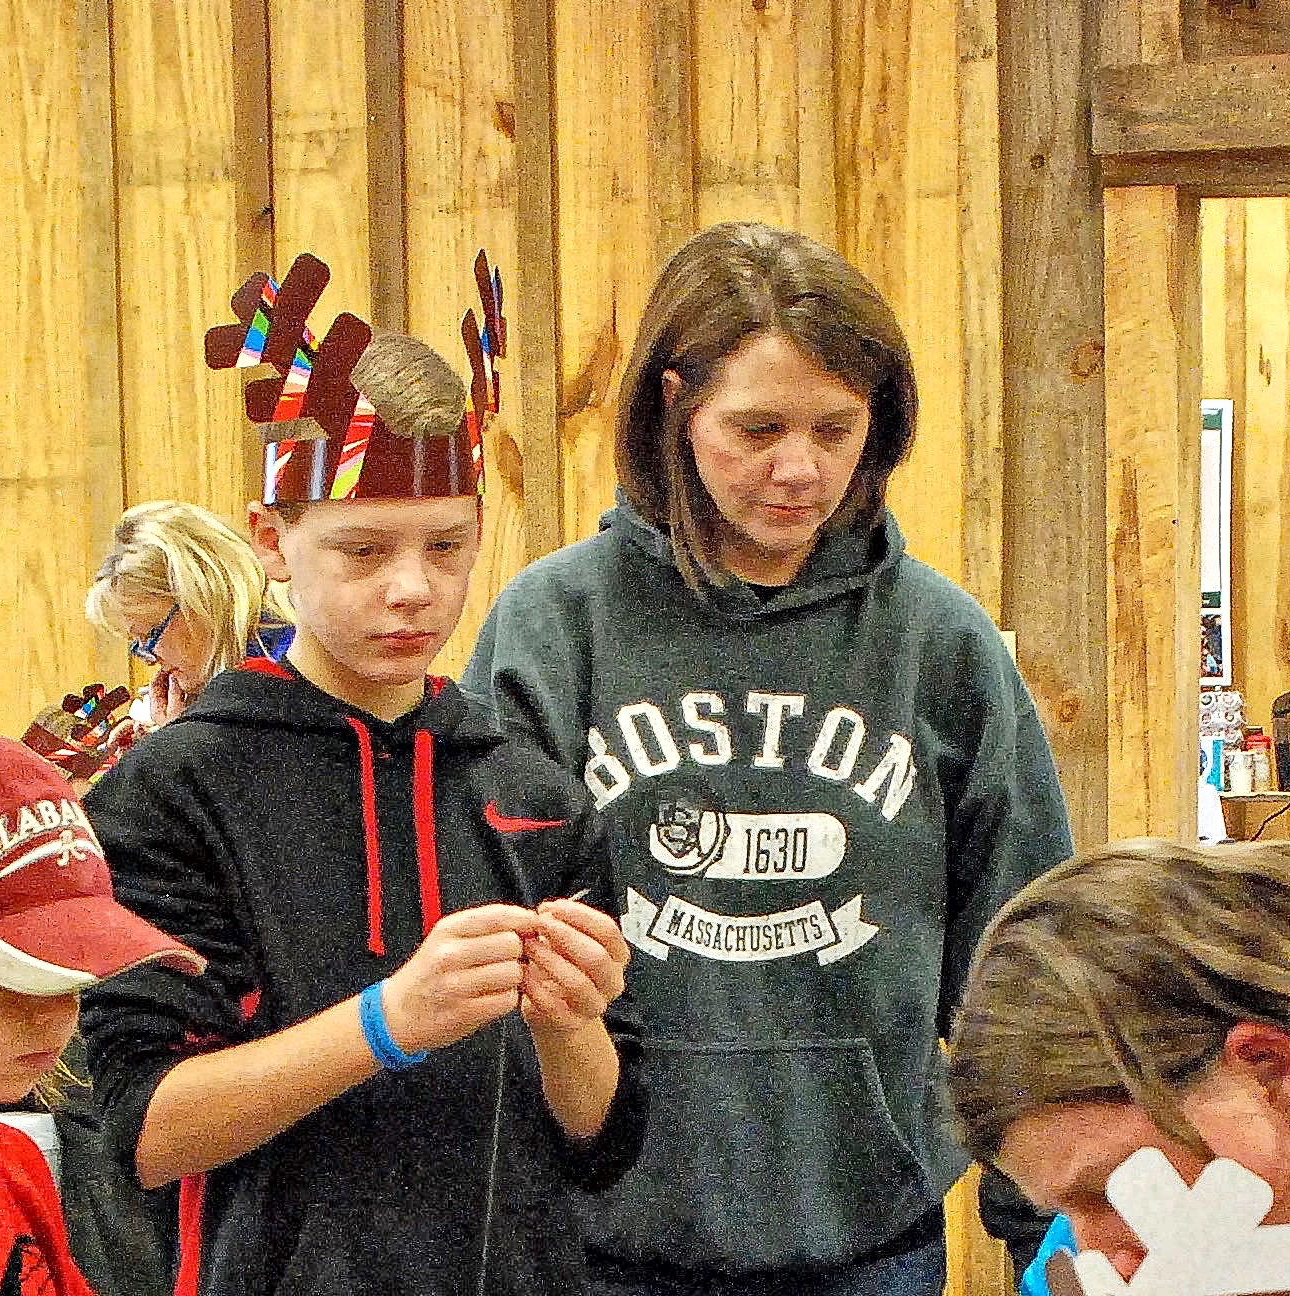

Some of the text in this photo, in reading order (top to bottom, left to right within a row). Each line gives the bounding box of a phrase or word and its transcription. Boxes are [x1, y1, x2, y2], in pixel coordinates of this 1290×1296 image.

[583, 690, 917, 822] BOSTON
[742, 827, 809, 876] 1630
[665, 906, 824, 953] MASSACHUSETTS
